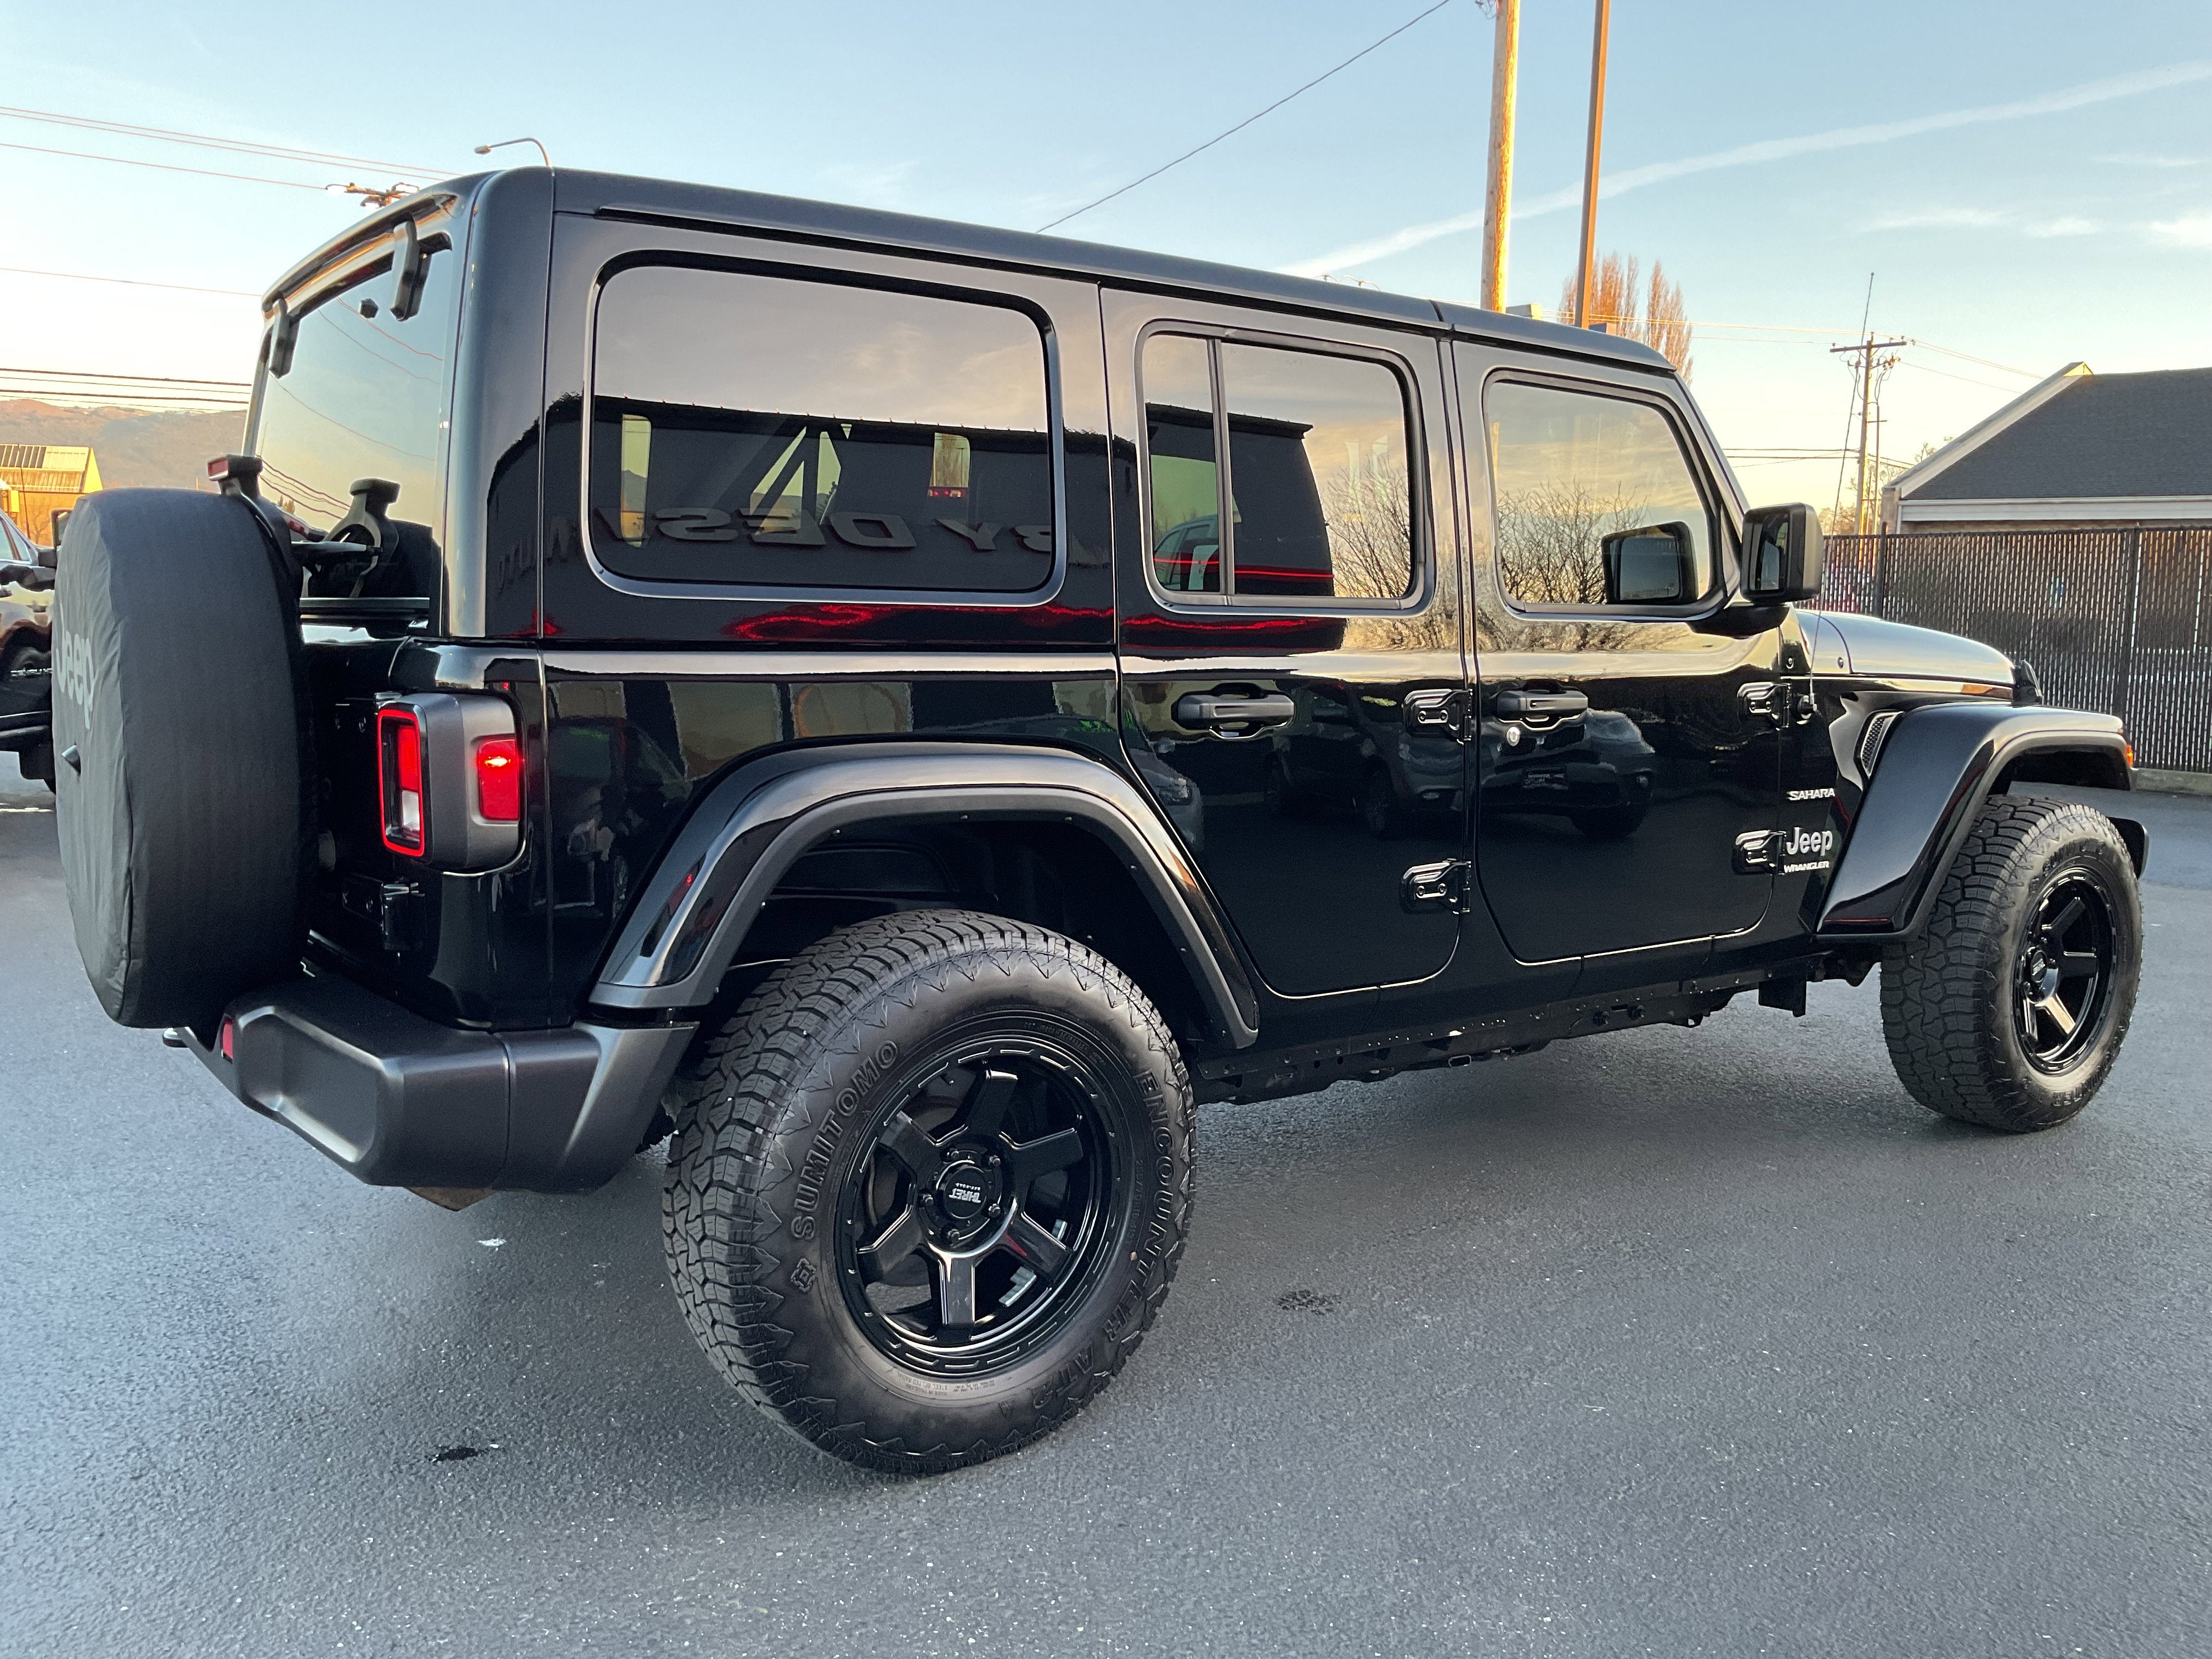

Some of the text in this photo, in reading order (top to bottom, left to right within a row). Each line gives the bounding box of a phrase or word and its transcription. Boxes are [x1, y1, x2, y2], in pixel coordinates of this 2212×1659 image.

[57, 602, 95, 730] Jeep
[1787, 788, 1835, 800] SAHARA
[1786, 827, 1833, 856] Jeep
[1784, 860, 1830, 873] WRANGLER
[792, 1040, 898, 1240] SUMITOMO
[949, 1188, 981, 1203] THRET
[1103, 1068, 1175, 1342] ENCOUNTER
[897, 1373, 912, 1383] RADIAL
[913, 1378, 931, 1387] BELTED
